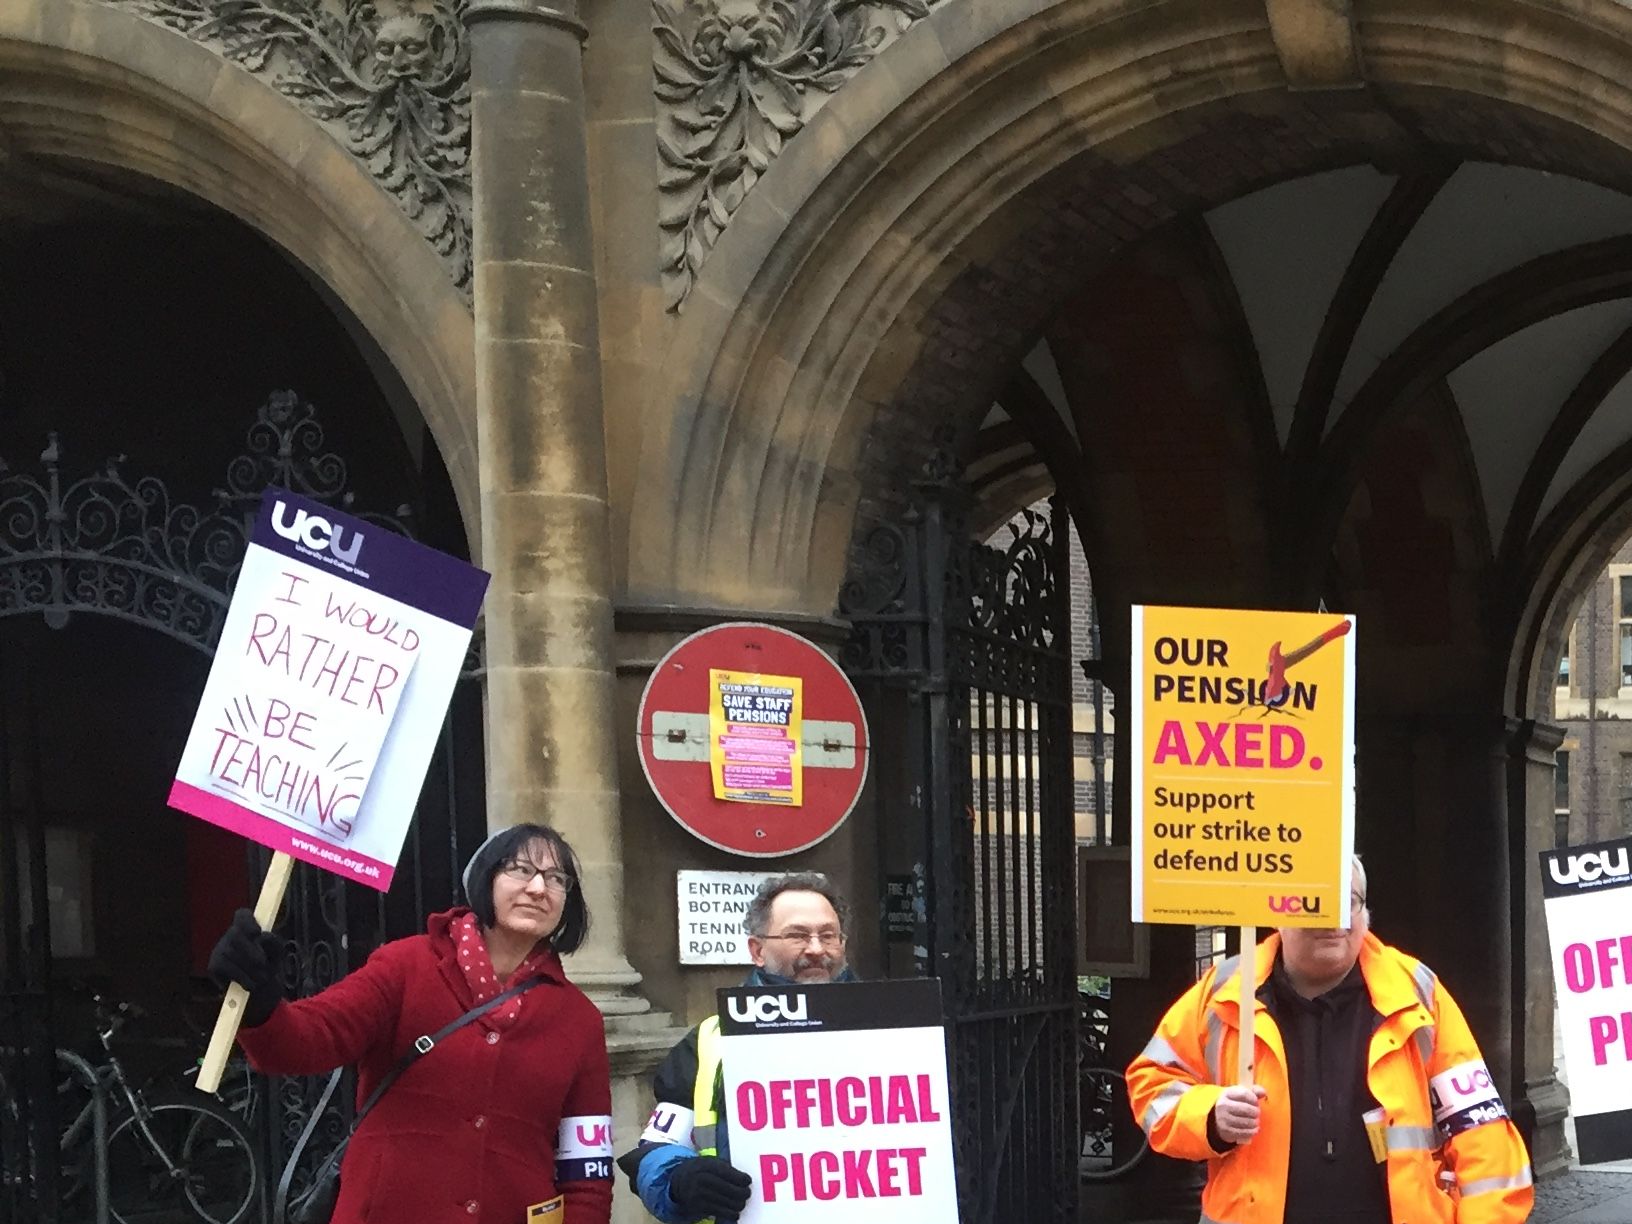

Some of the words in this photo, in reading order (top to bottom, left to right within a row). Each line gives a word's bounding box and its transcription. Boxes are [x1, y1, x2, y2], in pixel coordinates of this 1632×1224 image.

[275, 572, 309, 606] I
[325, 591, 420, 652] WOULD
[246, 613, 399, 715] RATHER
[1153, 636, 1229, 668] OUR
[723, 695, 752, 708] SAVE
[755, 696, 792, 711] STAFF
[1153, 673, 1318, 711] PENSION
[263, 698, 318, 751] BE
[728, 708, 787, 724] PENSIONS
[1152, 720, 1323, 771] AXED.
[209, 727, 360, 837] TEACHING
[1153, 786, 1255, 813] Support
[1153, 822, 1196, 840] our
[1202, 819, 1271, 843] strike
[1277, 823, 1302, 843] to
[291, 836, 380, 880] www.ucu.org.uk
[1153, 848, 1238, 873] defend
[1246, 853, 1294, 874] USS
[688, 882, 755, 896] ENTRAN
[689, 941, 737, 954] ROAD
[736, 1073, 940, 1132] OFFICIAL
[759, 1147, 927, 1203] PICKET
